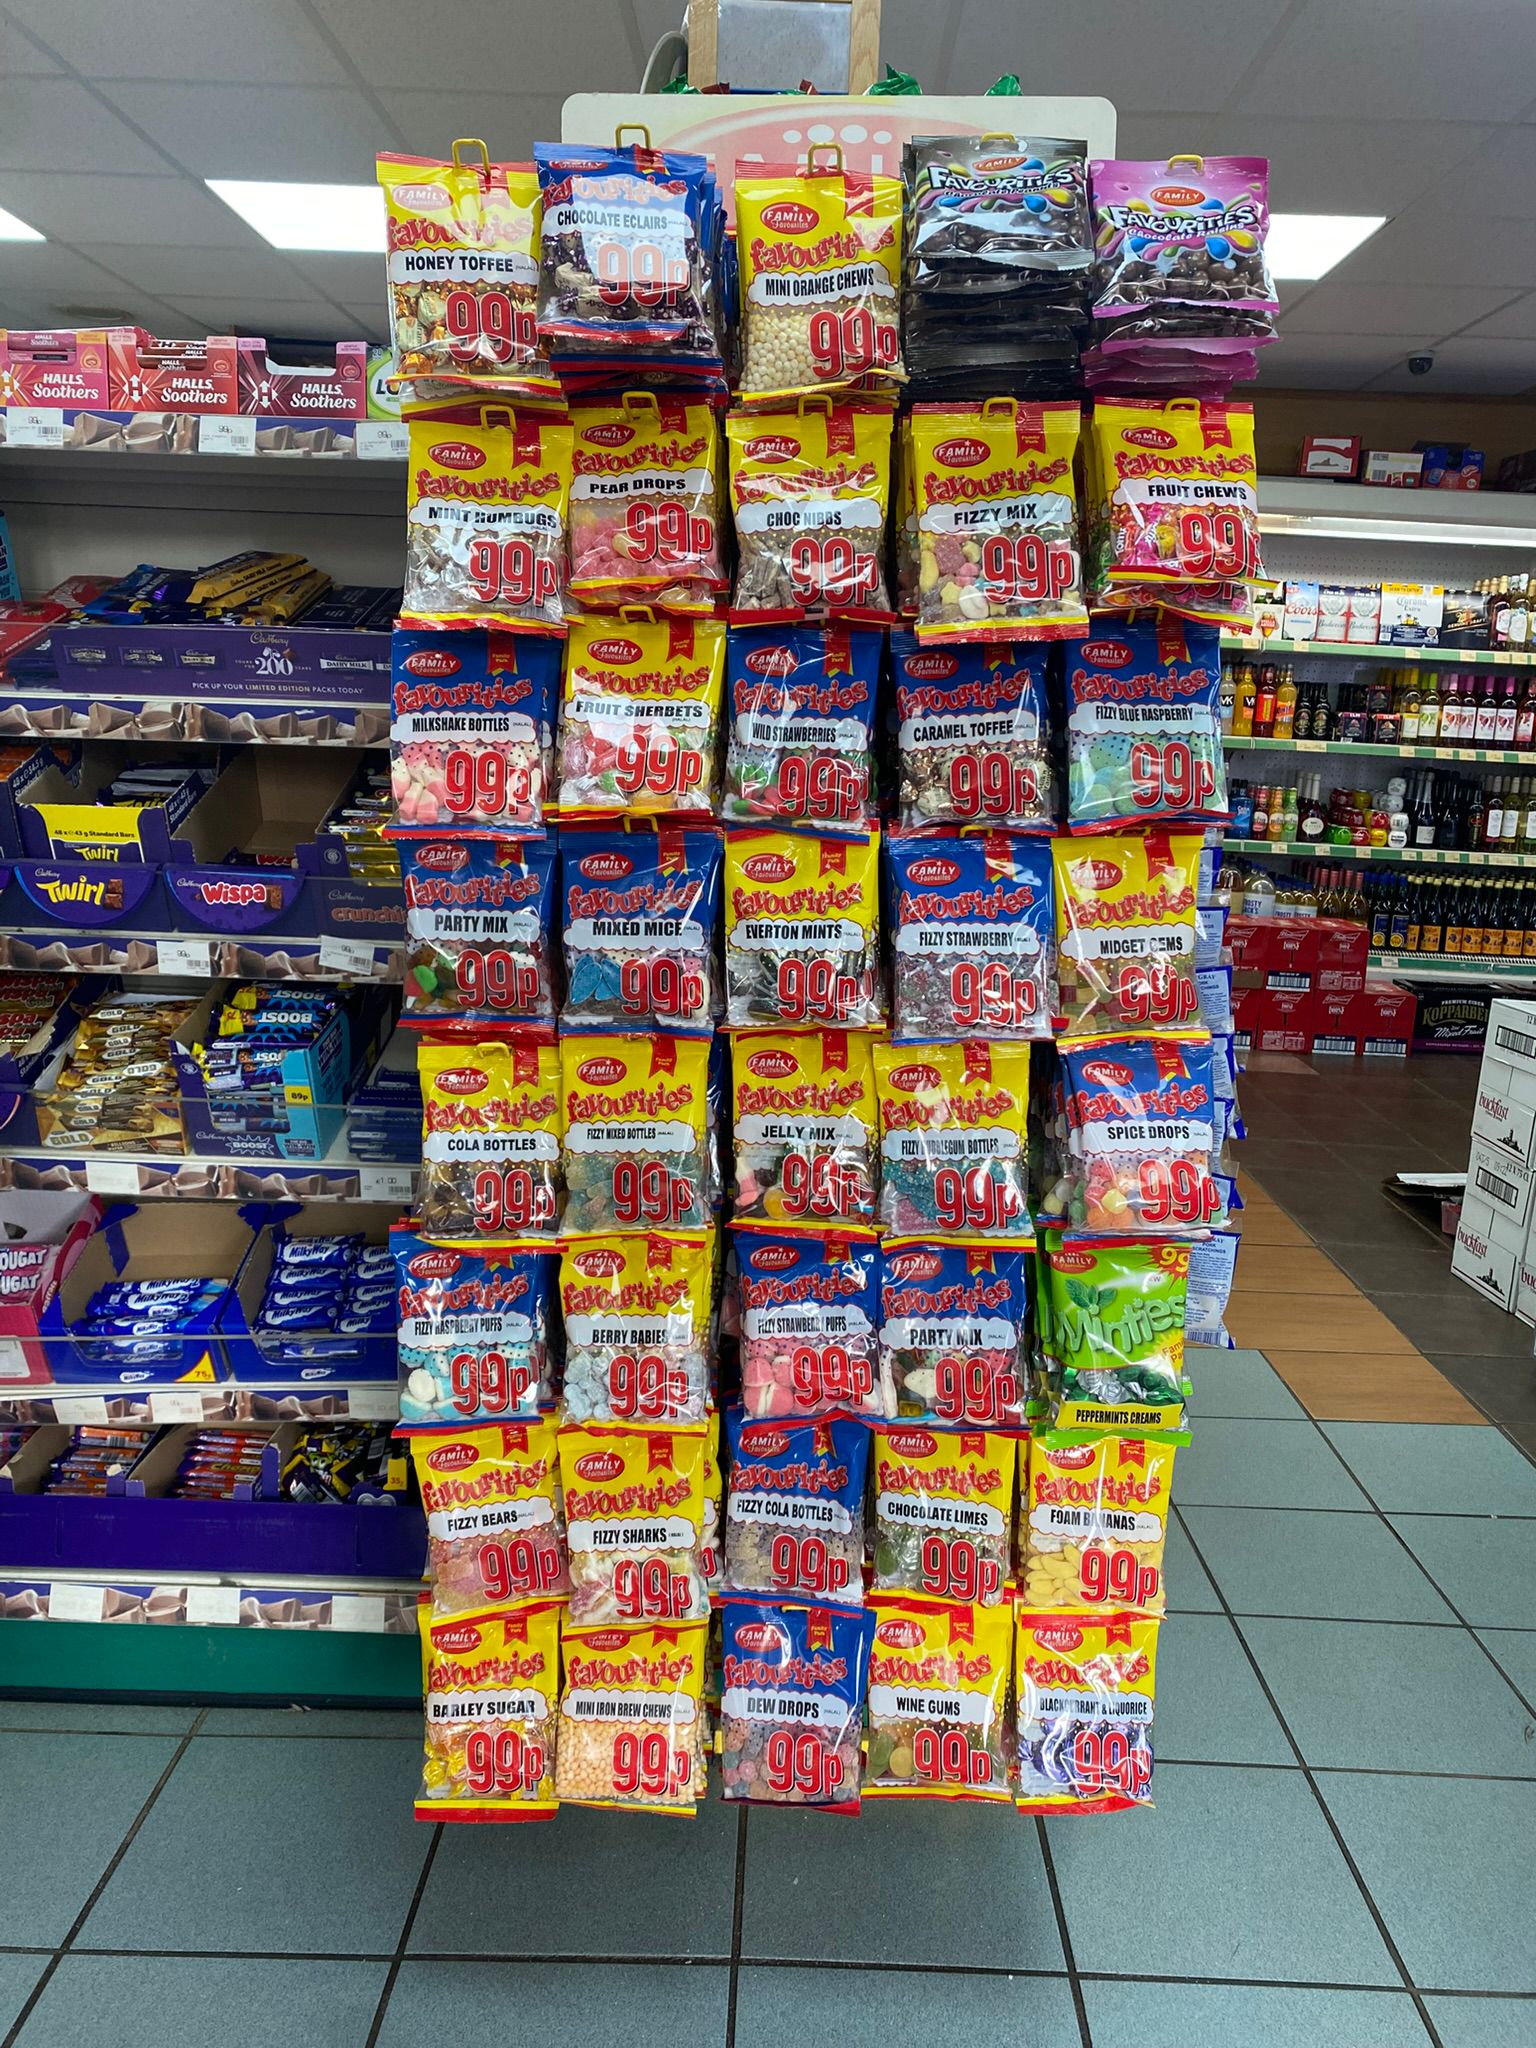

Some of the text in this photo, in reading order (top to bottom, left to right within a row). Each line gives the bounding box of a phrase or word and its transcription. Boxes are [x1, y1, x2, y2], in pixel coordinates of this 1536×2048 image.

[557, 210, 668, 230] CHOCOLATE ECLAIRS
[1128, 223, 1244, 241] Chocolate Raisins
[405, 255, 513, 272] HONEY TOFFEE
[766, 268, 874, 296] MINI ORANGE CHEWS
[445, 291, 539, 363] 99p
[43, 373, 83, 383] HALLS
[172, 378, 212, 388] HALLS
[32, 384, 99, 399] Soothers
[161, 388, 228, 403] Soothers
[302, 384, 342, 394] HALLS
[290, 394, 356, 409] Soothers
[939, 446, 985, 457] FAMILY
[590, 478, 686, 494] PEAR DROPS
[1149, 485, 1247, 499] FRUIT CHEWS
[429, 507, 557, 529] MINT HUMBUGS
[767, 511, 800, 527] CHOC
[954, 503, 1037, 526] FIZZY MIX
[982, 534, 1073, 603] 99p
[1286, 604, 1317, 615] Coors
[250, 632, 289, 646] Cadbury
[1084, 647, 1128, 658] FAMILY
[255, 657, 293, 675] 200
[576, 701, 702, 718] FRUIT SHERBETS
[1096, 705, 1193, 721] FIZZY BLUE RASPBERRY
[412, 716, 509, 732] MILKSHAKE BOTTLES
[914, 719, 1014, 742] CARAMEL TOFFEE
[753, 725, 837, 742] WILD STRAWBERRIES
[950, 753, 1037, 817] 99p
[74, 845, 119, 862] Twirl
[35, 868, 60, 878] Cadbury
[36, 875, 105, 905] Twirl
[201, 882, 266, 905] Wispa
[329, 890, 364, 901] Cadbury
[435, 916, 508, 933] PARTY MIX
[592, 921, 683, 936] MIXED MICE
[746, 924, 842, 940] EVERTON MINTS
[919, 931, 1013, 948] FIZZY STRAWBERRY
[1100, 939, 1145, 954] MIDGET
[621, 959, 703, 1018] 99p
[259, 1012, 312, 1022] BOOST
[1434, 1025, 1484, 1037] Mixed Fruit
[291, 1092, 309, 1101] 89p
[1479, 1091, 1509, 1121] buckfast
[50, 1133, 90, 1145] GOLD
[196, 1132, 225, 1140] Cadbury
[587, 1128, 656, 1140] FIZZY MIXED BOTTLES
[762, 1125, 835, 1140] JELLY MIX
[1108, 1126, 1189, 1139] SPICE DROPS
[447, 1138, 537, 1151] COLA BOTTLES
[902, 1139, 919, 1155] FIZZY
[968, 1139, 999, 1154] BOTTLES
[1458, 1227, 1487, 1258] buckfast
[0, 1250, 47, 1270] OUGAT
[1053, 1256, 1092, 1265] FAMILY
[415, 1320, 434, 1335] FIZZY
[480, 1317, 502, 1332] PUFFS
[758, 1318, 775, 1334] FIZZY
[826, 1316, 847, 1332] PUFFS
[1057, 1295, 1186, 1354] Minties
[593, 1329, 668, 1344] BERRY BABIES
[910, 1328, 982, 1346] PARTY MIX
[609, 1354, 688, 1417] 99p
[1076, 1409, 1161, 1424] PEPPERMINTS CREAMS
[737, 1499, 833, 1522] FIZZY COLA BOTTLES
[888, 1502, 988, 1526] CHOCOLATE LIMES
[1051, 1509, 1080, 1525] FOAM
[448, 1510, 518, 1531] FIZZY BEARS
[593, 1528, 667, 1545] FIZZY SHARKS
[1080, 1547, 1158, 1606] 99p
[614, 1558, 692, 1618] 99p
[434, 1700, 535, 1718] BARLEY SUGAR
[576, 1702, 672, 1719] MINI IRON BREW CHEWS
[747, 1697, 819, 1719] DEW DROPS
[897, 1697, 960, 1716] WINE GUMS
[1102, 1704, 1107, 1714] &
[1109, 1701, 1147, 1715] LIQUORICE
